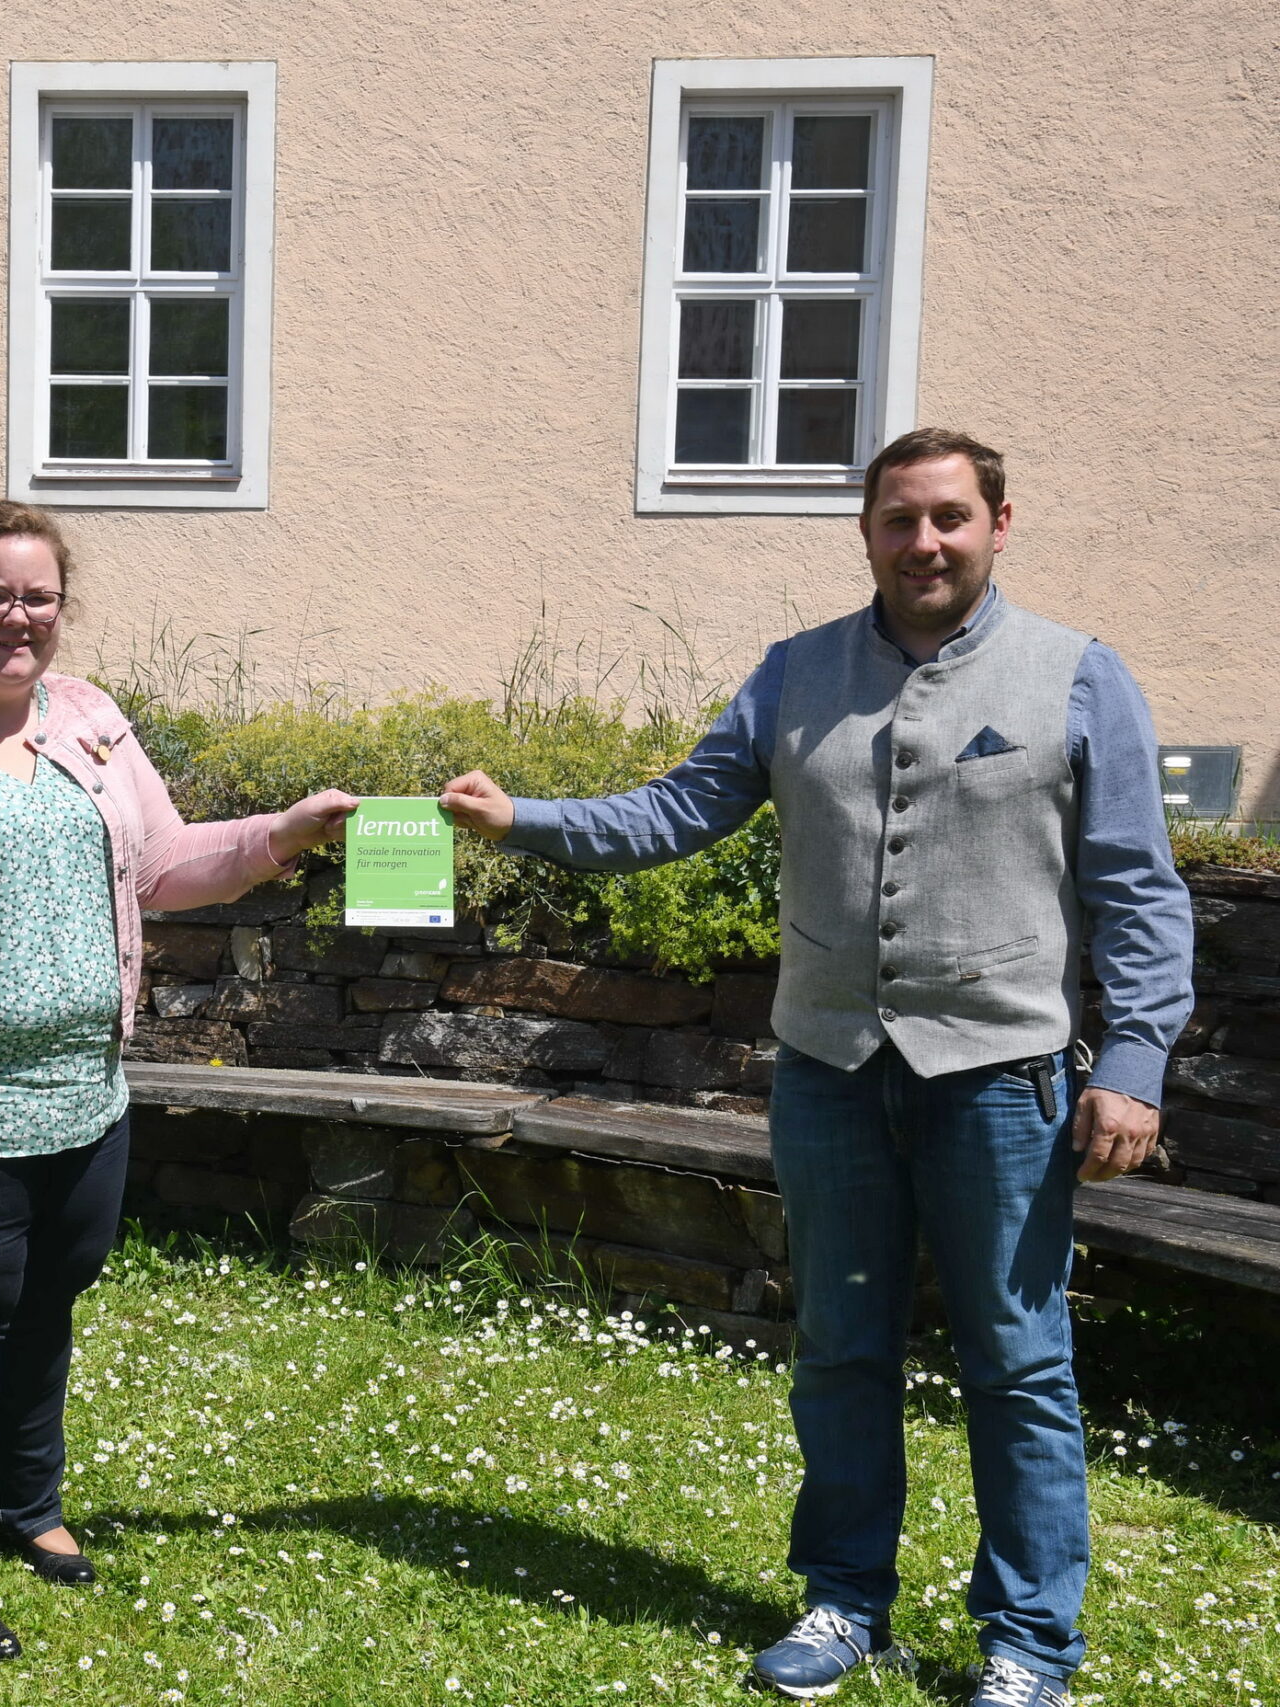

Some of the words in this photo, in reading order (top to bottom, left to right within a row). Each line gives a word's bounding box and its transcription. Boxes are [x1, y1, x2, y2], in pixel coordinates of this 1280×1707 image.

[356, 814, 441, 837] lernort
[357, 847, 390, 856] Soziale
[392, 848, 441, 856] Innovation
[356, 859, 371, 870] für
[373, 861, 408, 870] morgen
